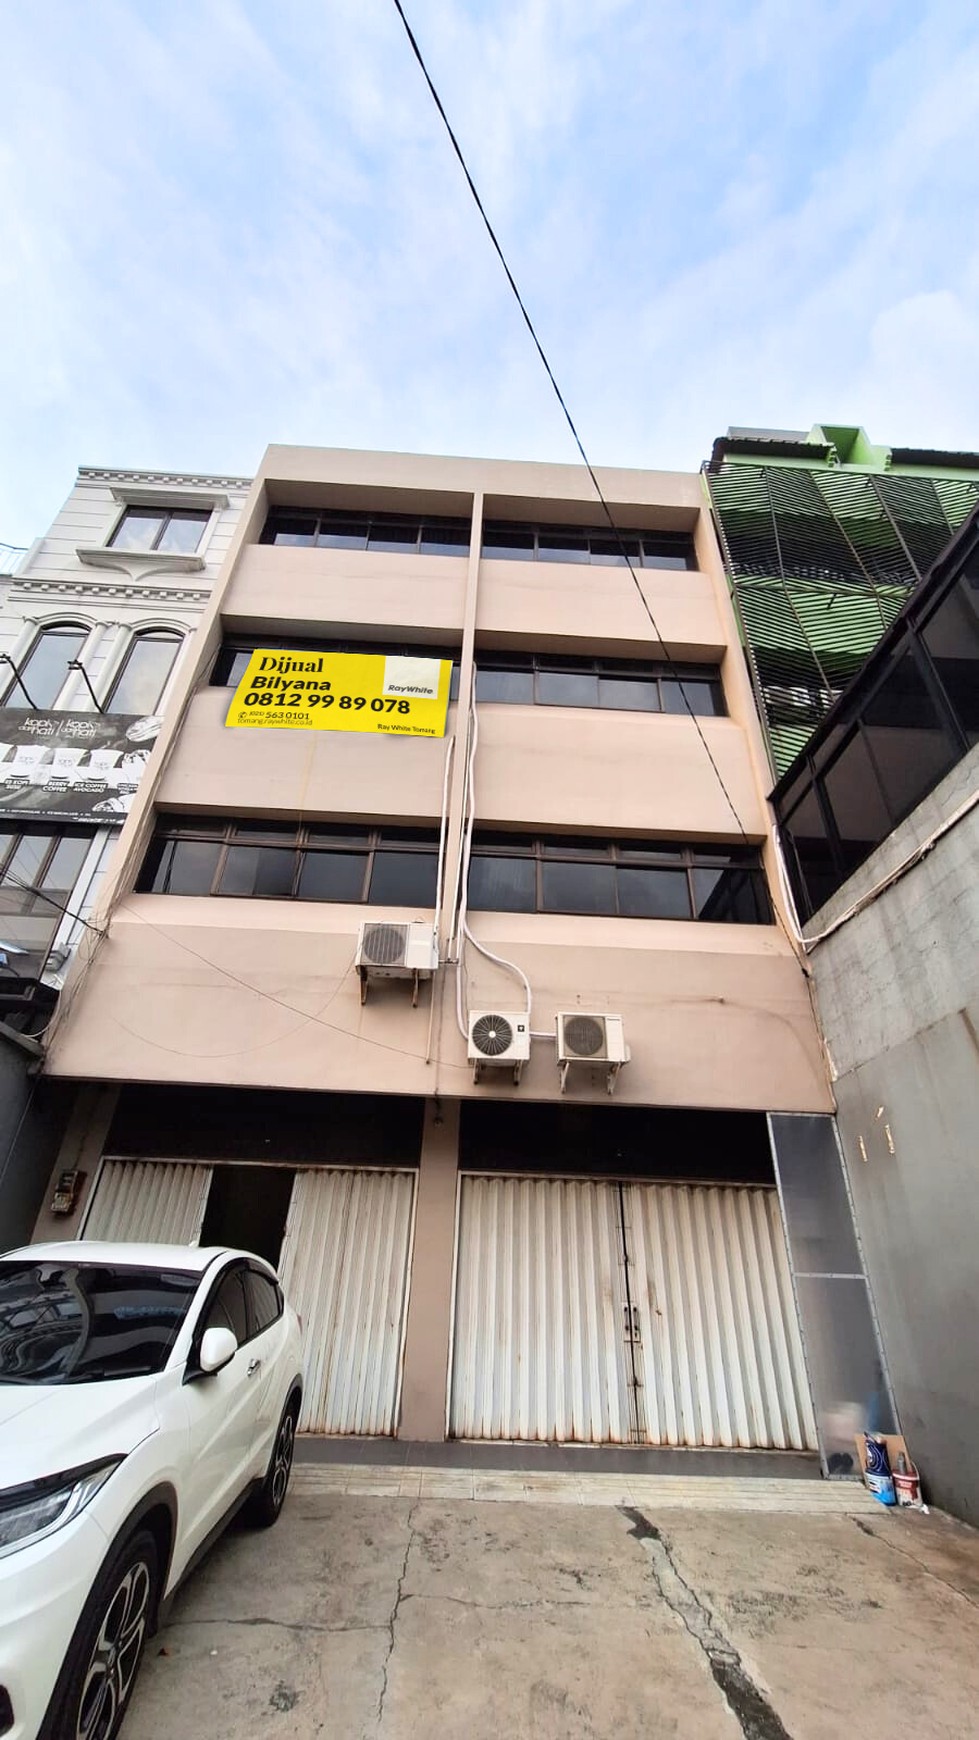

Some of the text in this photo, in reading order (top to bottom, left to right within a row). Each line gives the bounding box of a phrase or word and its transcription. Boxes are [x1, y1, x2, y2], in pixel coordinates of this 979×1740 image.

[259, 656, 324, 674] Dijual
[250, 676, 332, 691] Bilyana
[387, 684, 434, 695] RayWhite
[243, 692, 410, 714] 0812 99 89 078
[265, 711, 285, 719] 563
[285, 712, 310, 720] 0101
[377, 723, 390, 731] Ray
